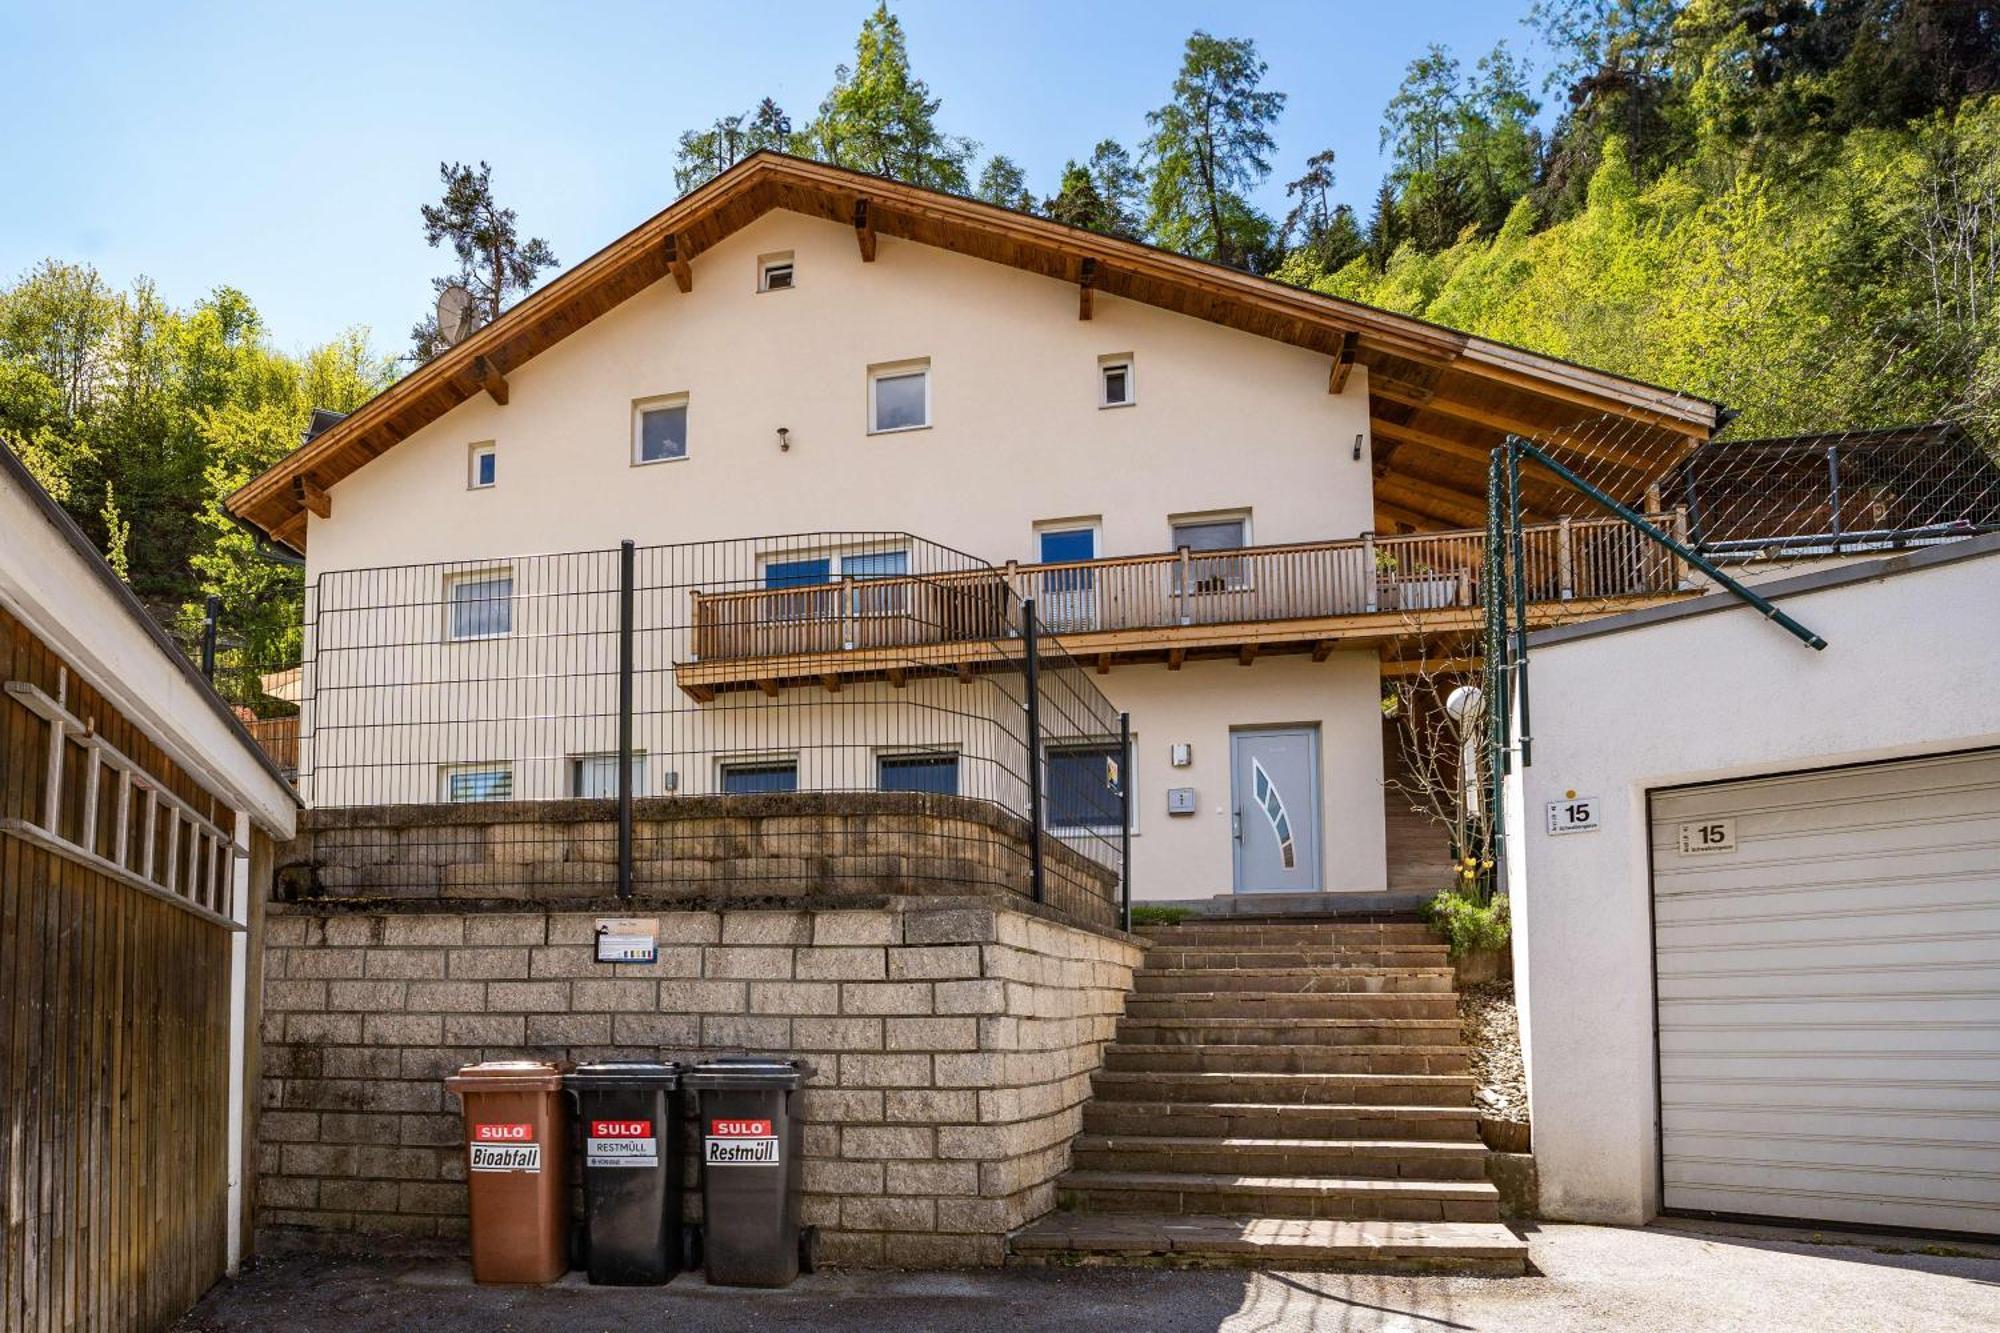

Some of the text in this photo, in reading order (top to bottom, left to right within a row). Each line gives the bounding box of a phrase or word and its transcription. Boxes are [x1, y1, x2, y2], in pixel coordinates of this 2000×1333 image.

[1565, 804, 1590, 823] 15
[1697, 824, 1725, 844] 15
[481, 1127, 524, 1138] SULO
[598, 1124, 642, 1135] SULO
[717, 1123, 763, 1134] SULO
[597, 1141, 646, 1152] RESTMÜLL
[710, 1141, 774, 1160] Restmüll
[473, 1148, 538, 1166] Bioabfall
